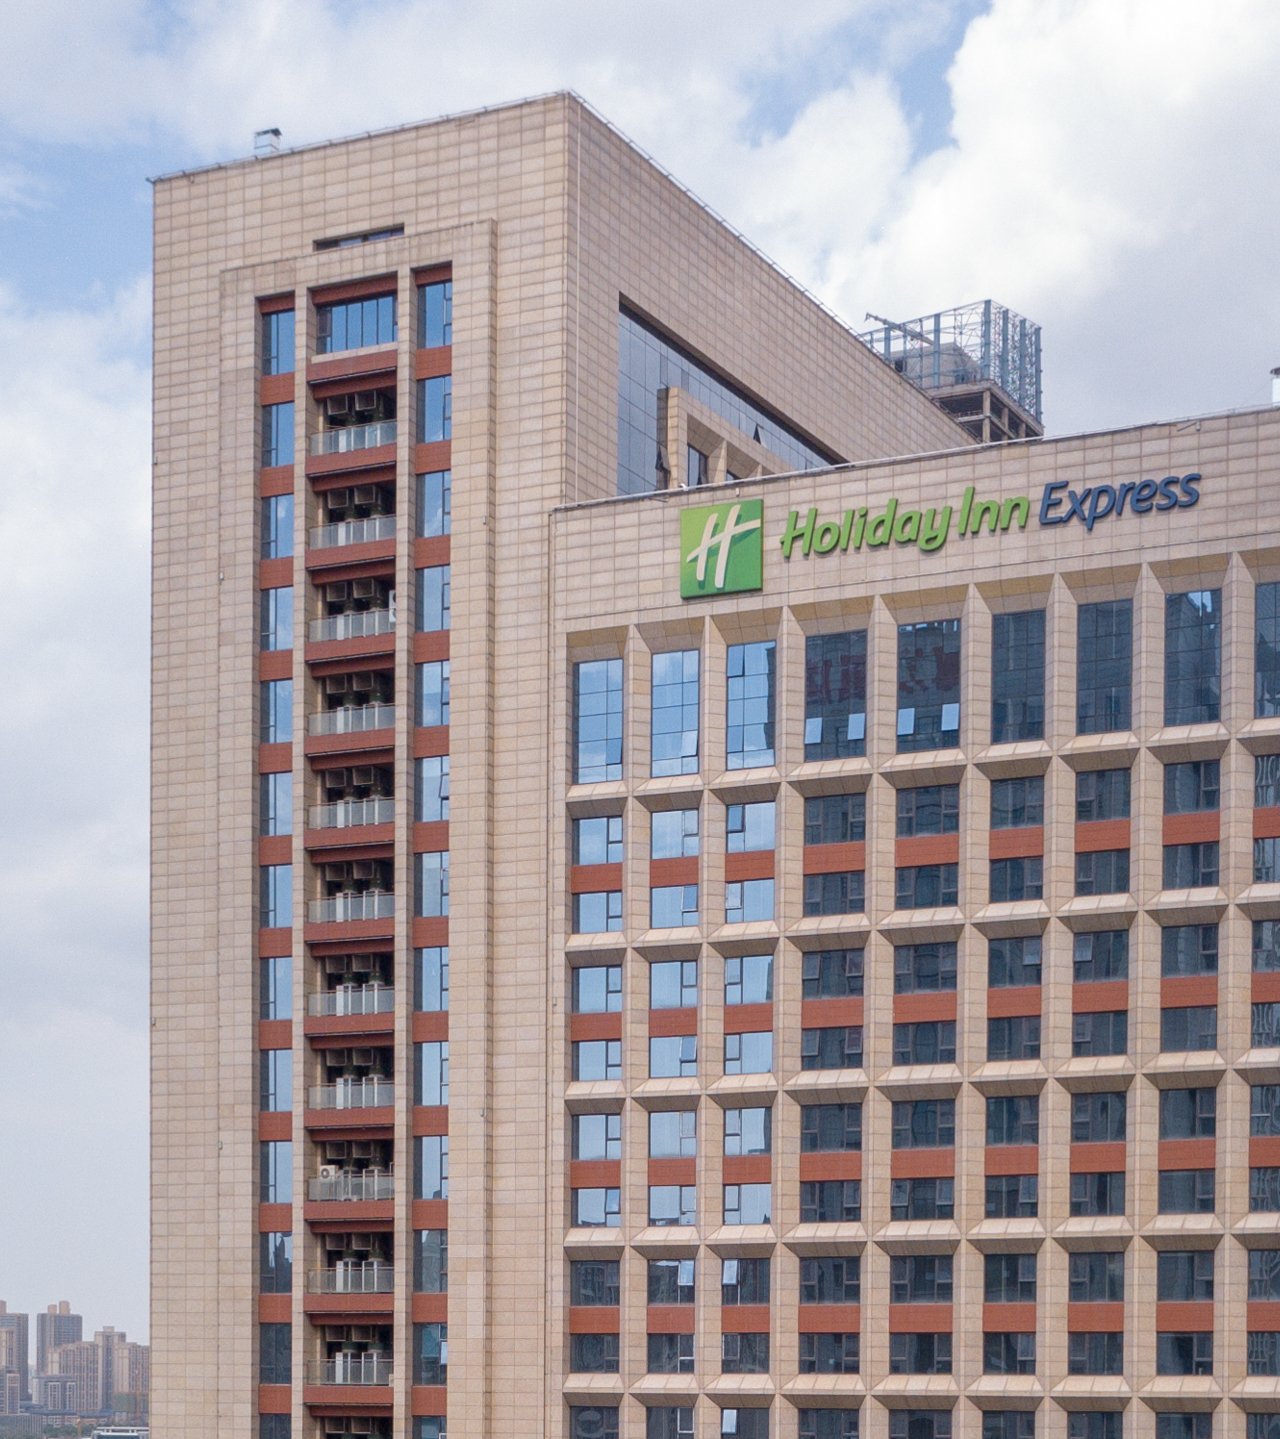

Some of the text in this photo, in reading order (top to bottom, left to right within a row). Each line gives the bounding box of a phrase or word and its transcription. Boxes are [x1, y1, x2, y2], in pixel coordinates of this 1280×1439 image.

[780, 472, 1202, 558] Holiday Inn Express
